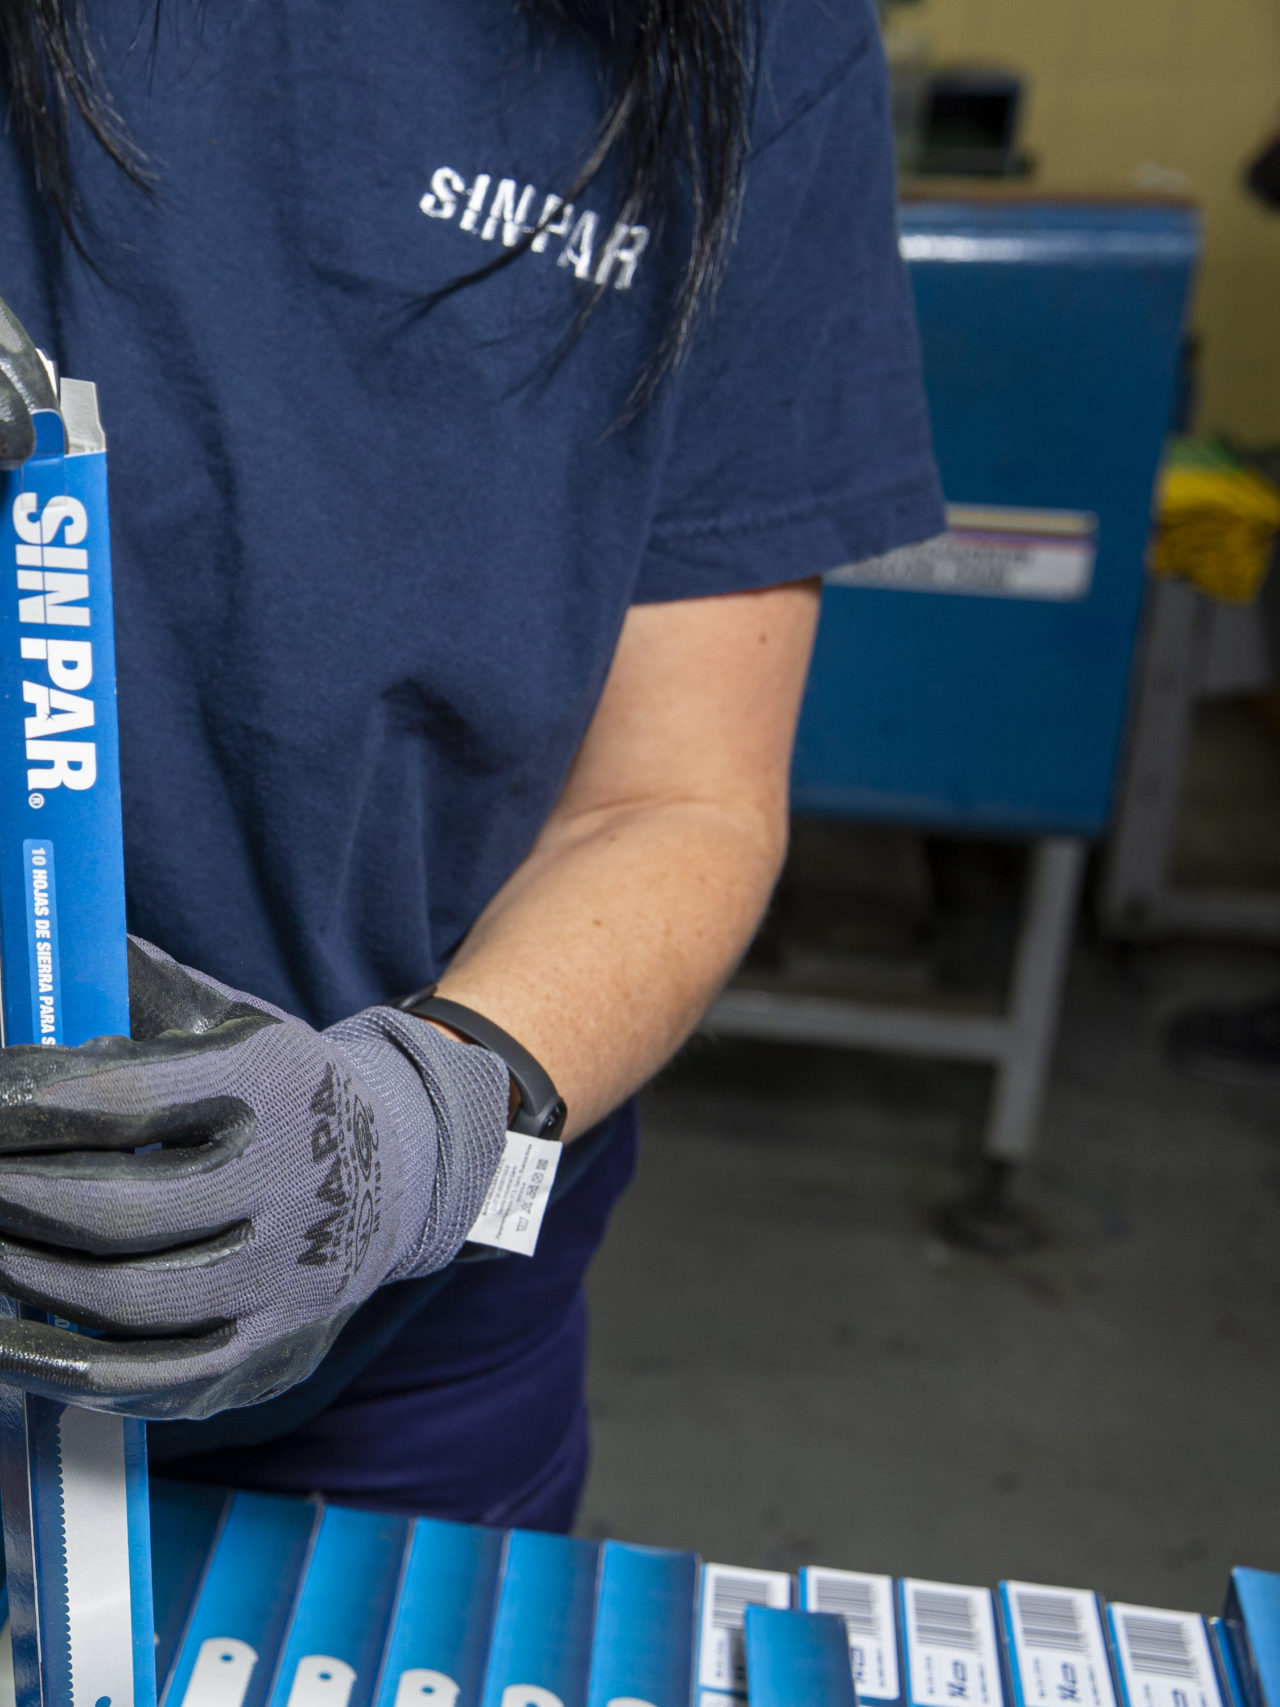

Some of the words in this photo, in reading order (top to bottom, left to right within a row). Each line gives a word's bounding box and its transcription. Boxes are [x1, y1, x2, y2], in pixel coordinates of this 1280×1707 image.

[32, 848, 46, 866] 10
[33, 869, 50, 917] HOJAS
[35, 920, 51, 939] DE
[36, 942, 53, 993] SIERRA
[39, 996, 55, 1034] PARA
[297, 1062, 349, 1266] MAPA
